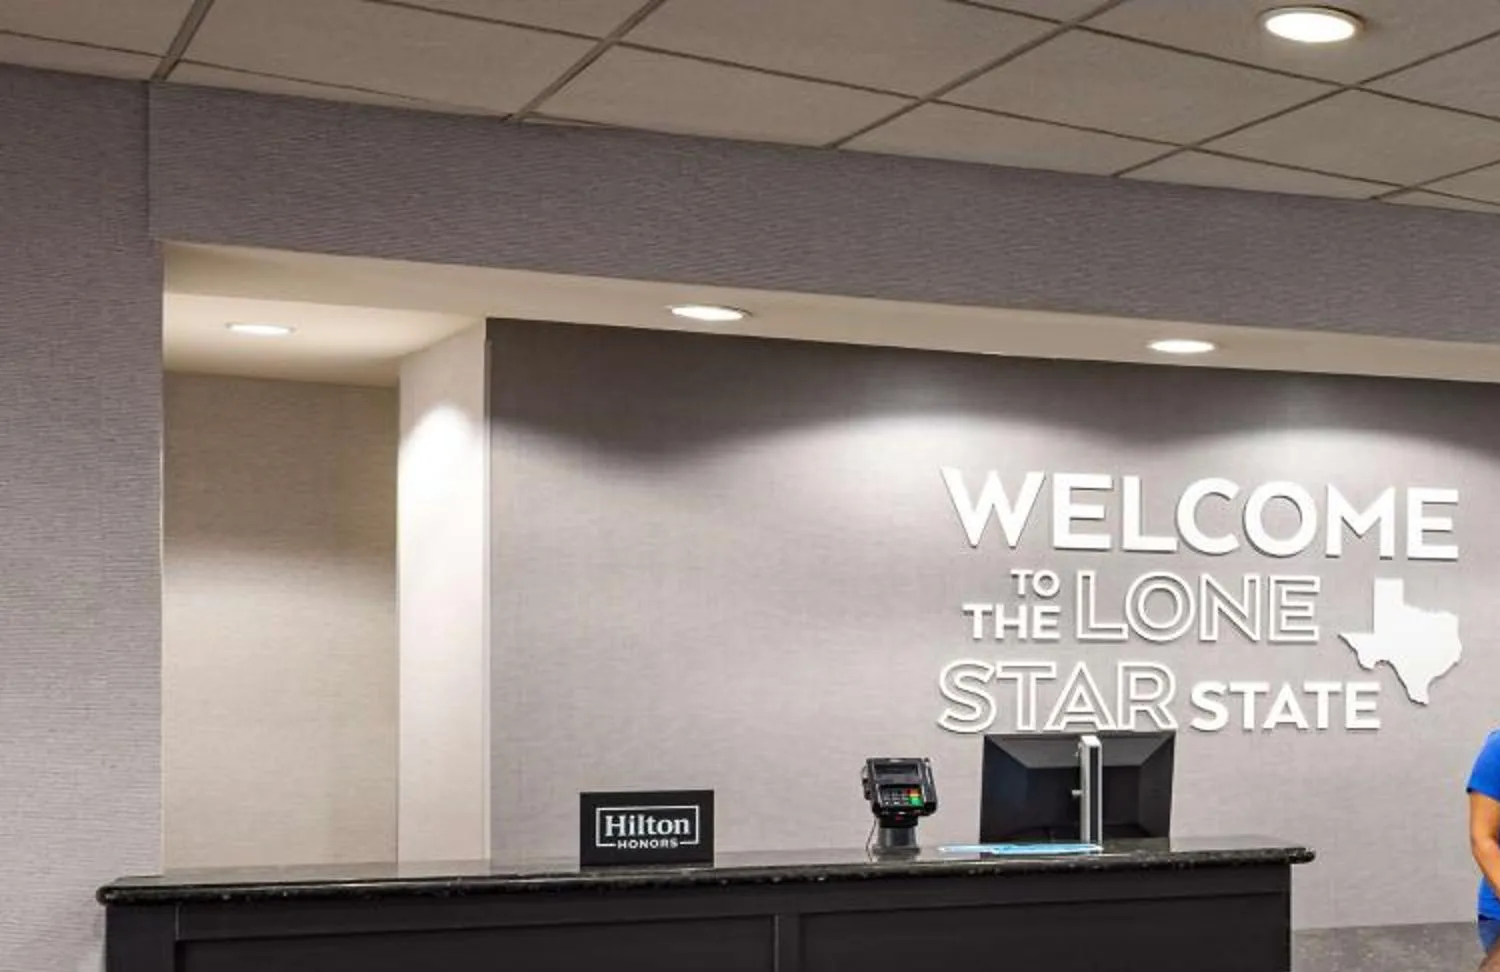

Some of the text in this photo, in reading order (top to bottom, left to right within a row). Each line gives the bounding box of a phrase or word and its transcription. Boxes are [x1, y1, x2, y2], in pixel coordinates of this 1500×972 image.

[940, 467, 1459, 560] WELCOME
[1010, 569, 1060, 598] TO
[963, 603, 1060, 640] THE
[1076, 570, 1321, 644] LONE
[937, 659, 1383, 734] STAR STATE
[605, 814, 691, 837] Hilton
[617, 837, 679, 849] HONORS
